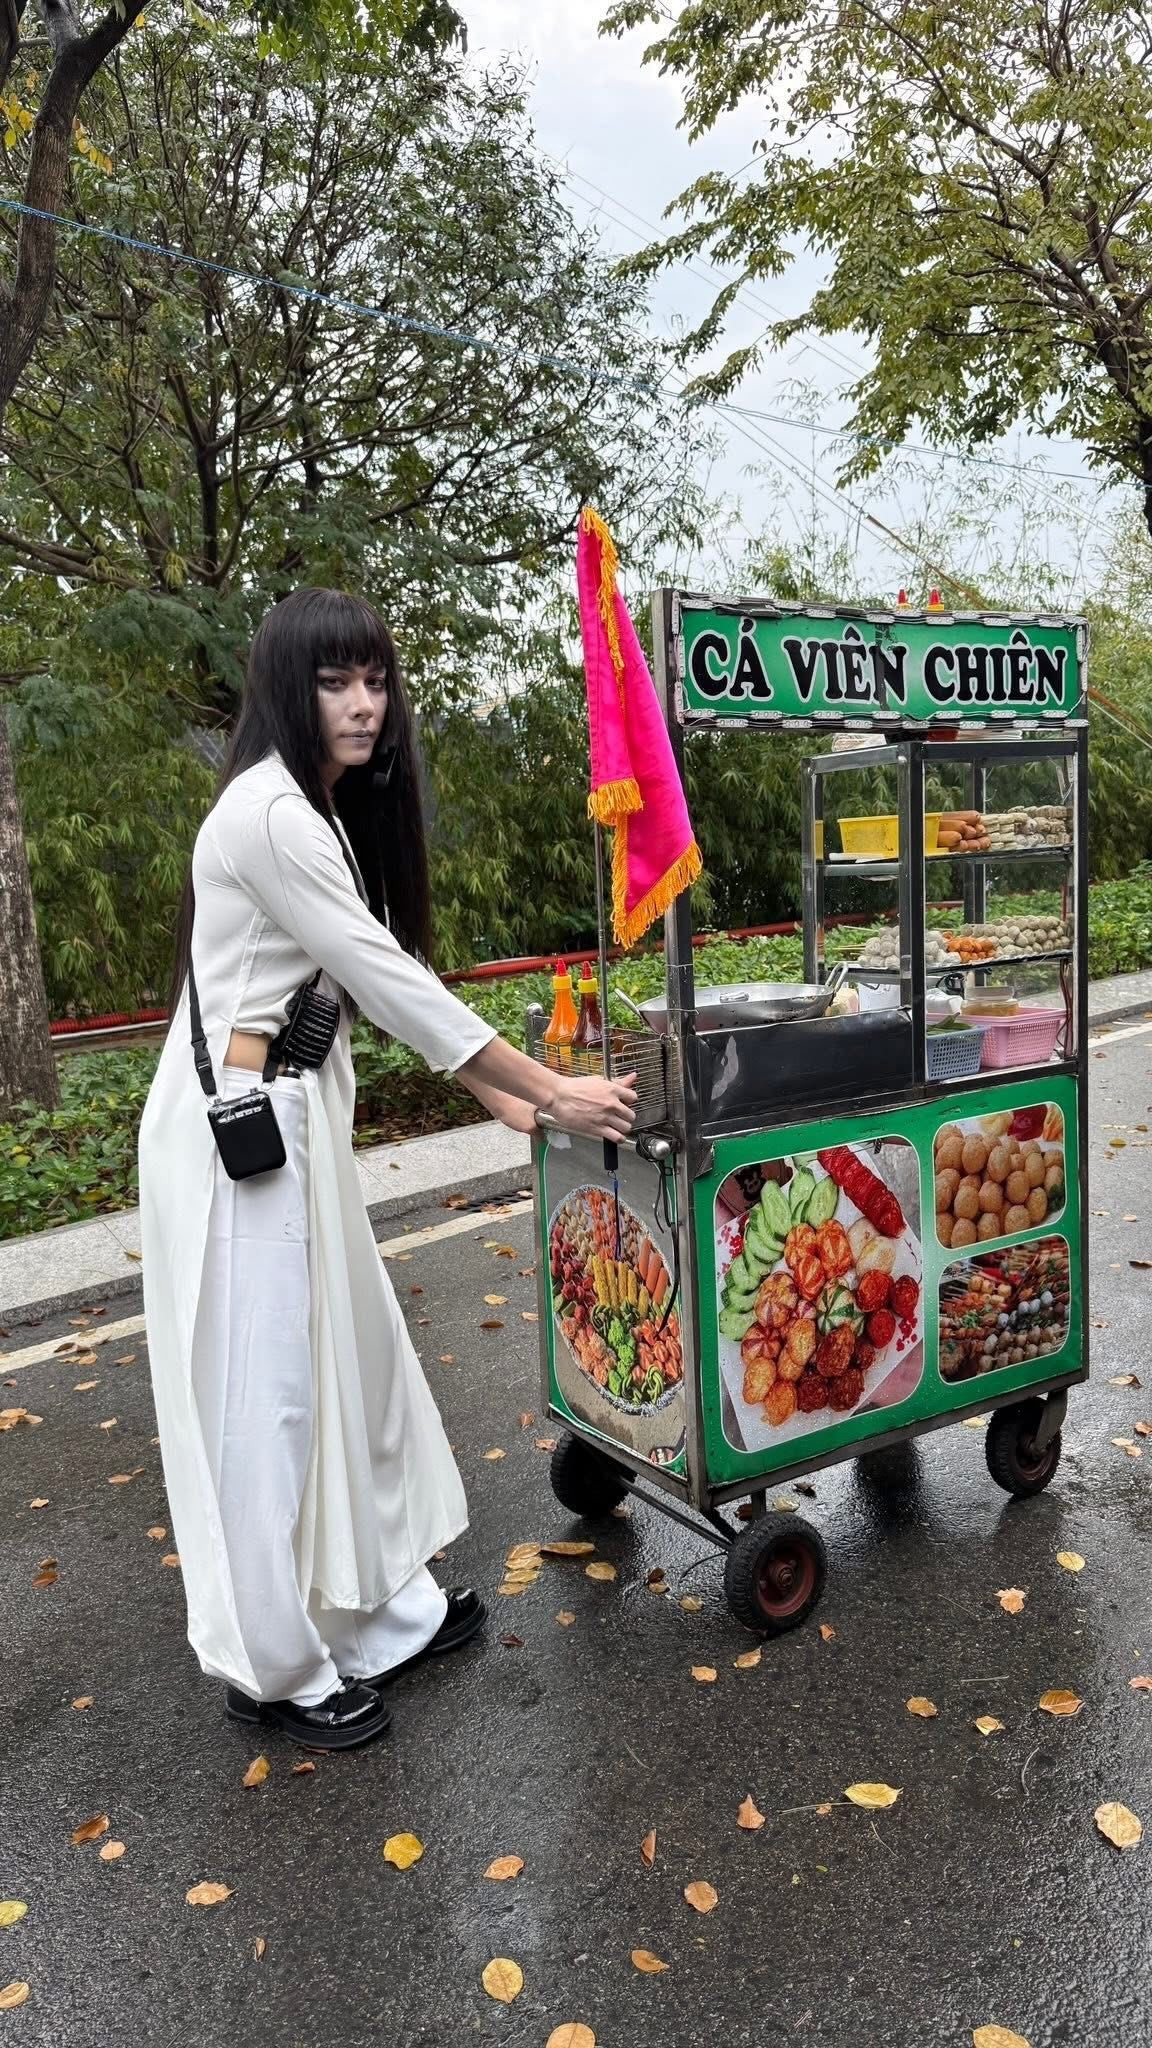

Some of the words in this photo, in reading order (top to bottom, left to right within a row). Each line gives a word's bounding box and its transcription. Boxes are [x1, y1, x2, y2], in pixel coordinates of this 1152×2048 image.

[691, 617, 773, 700] CÁ
[783, 622, 908, 705] VIÊN
[924, 628, 1068, 706] CHIÊN
